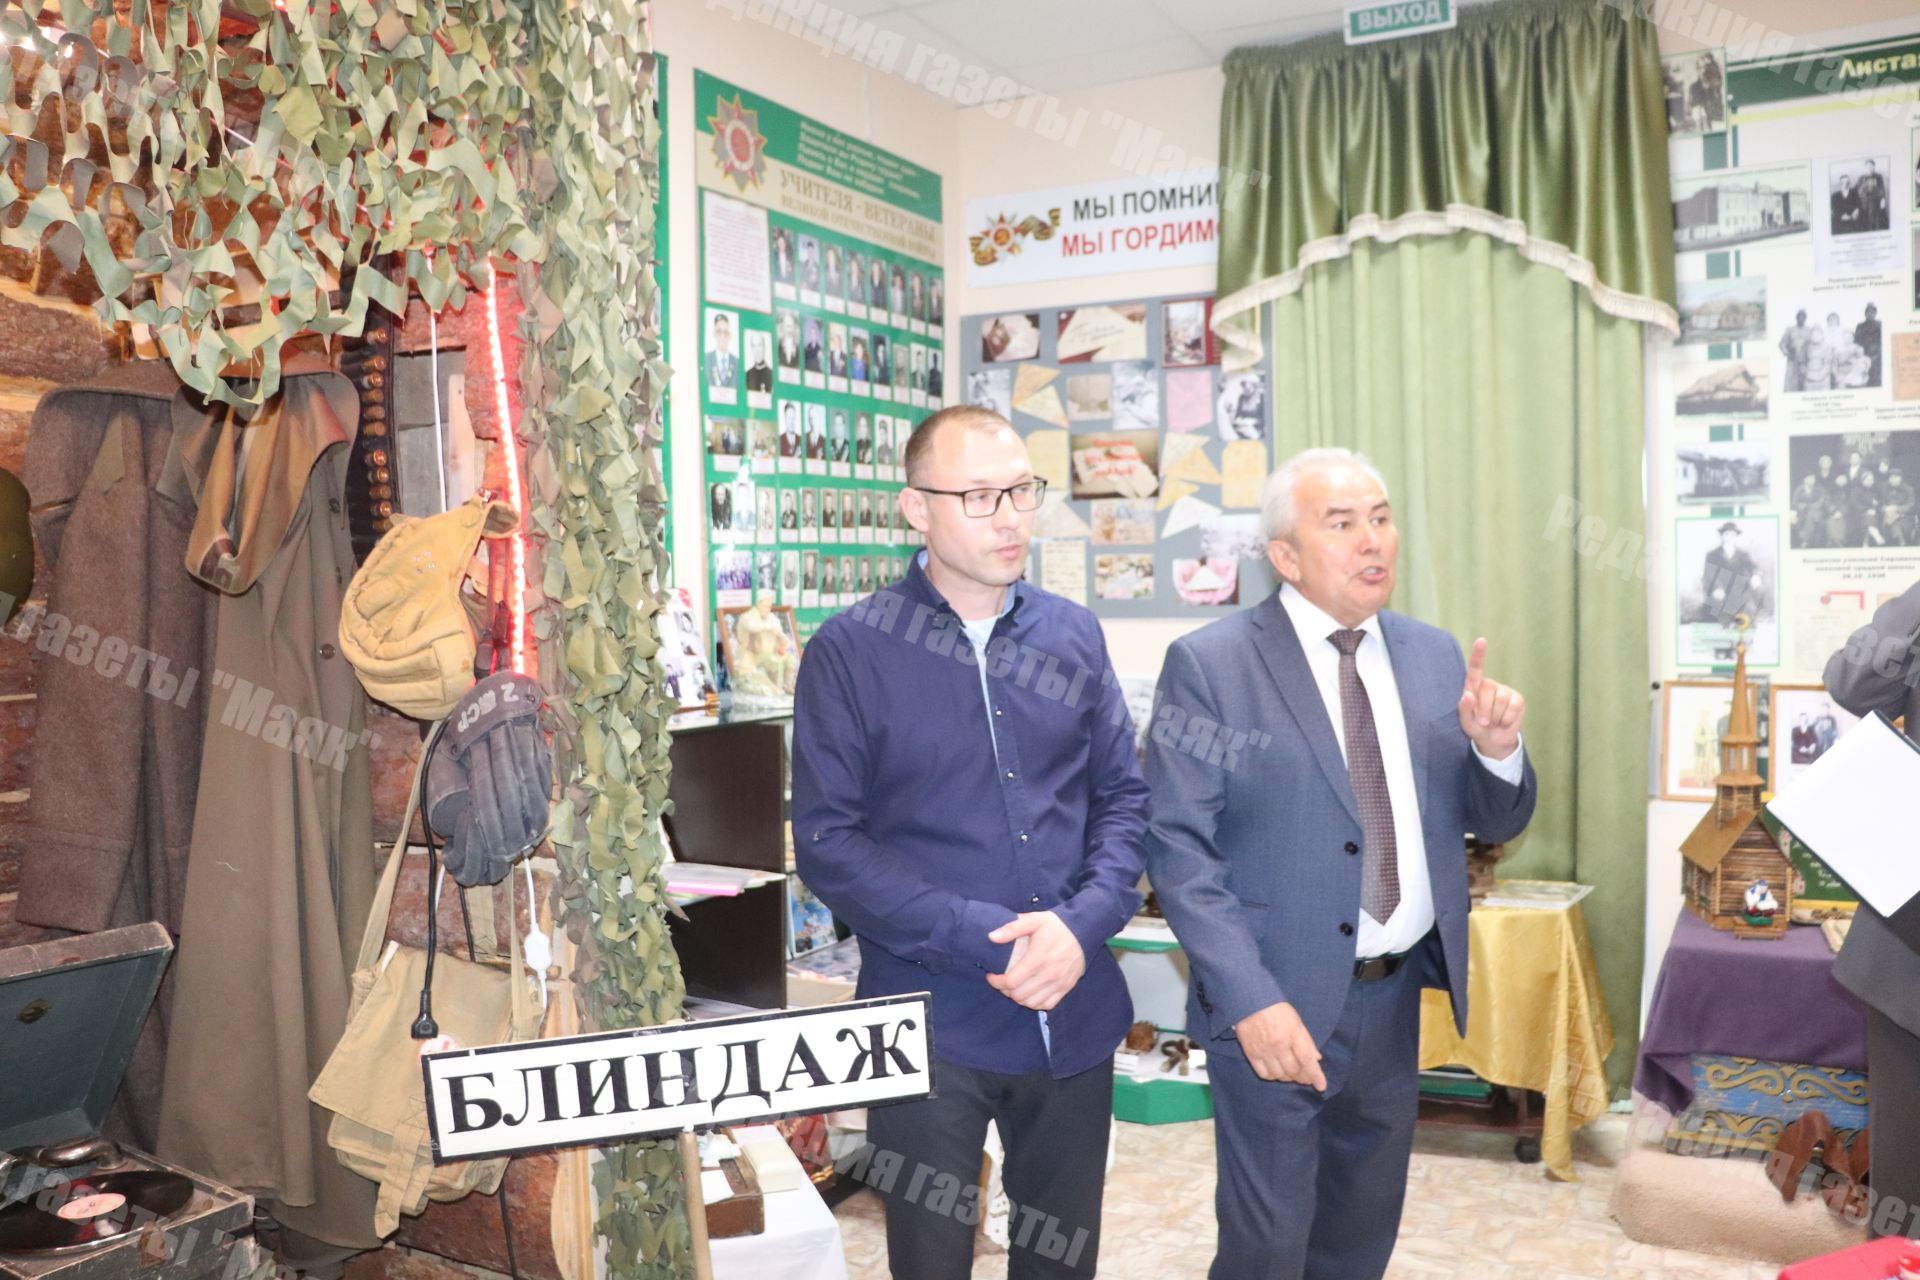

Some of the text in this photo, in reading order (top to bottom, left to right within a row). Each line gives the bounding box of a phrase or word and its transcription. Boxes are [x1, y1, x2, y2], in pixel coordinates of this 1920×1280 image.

[1358, 1, 1441, 31] ВЫХОД
[1839, 53, 1920, 80] Листа
[780, 169, 854, 212] УЧИТЕЛЯ
[864, 201, 936, 242] ВЕТЕРАНЫ
[1073, 182, 1220, 222] МЫ ПОМНИ
[1062, 231, 1103, 257] МЫ
[440, 1018, 922, 1135] БЛИНДАЖ
